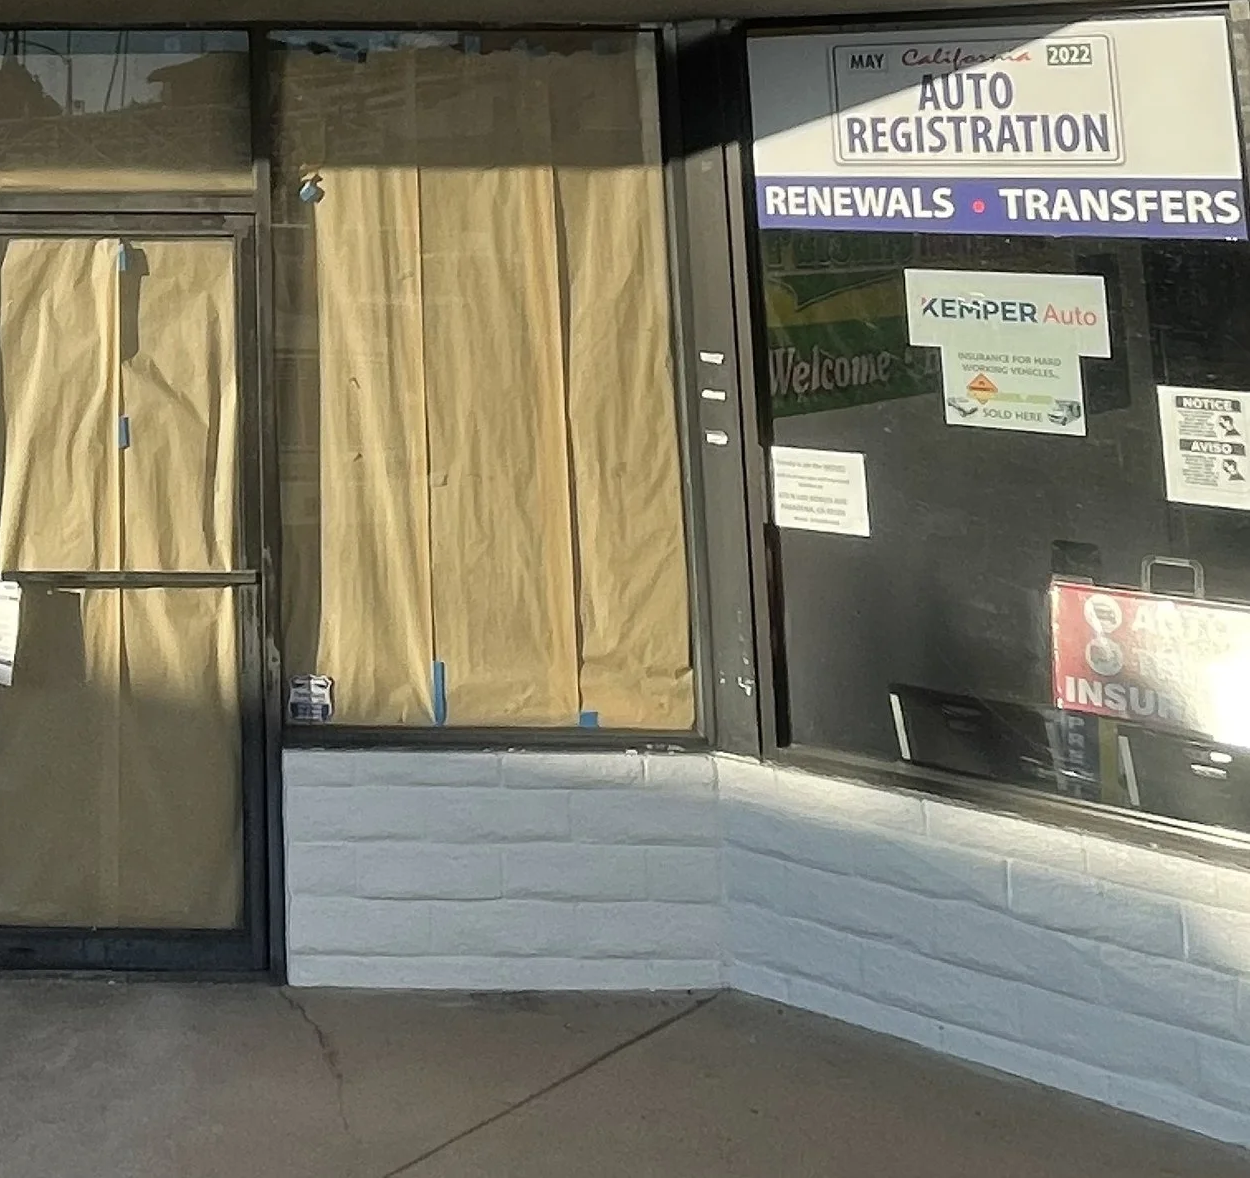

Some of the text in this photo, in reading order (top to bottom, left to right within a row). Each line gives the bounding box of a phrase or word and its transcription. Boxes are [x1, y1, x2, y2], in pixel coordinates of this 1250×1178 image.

[850, 45, 1092, 71] MAY California 2022
[918, 72, 1014, 111] AUTO
[846, 113, 1111, 154] REGISTRATION
[764, 185, 1241, 224] RENEWALS TRANSFERS
[921, 297, 1098, 326] KEMPER Auto
[769, 344, 892, 397] Welcome
[958, 352, 1062, 367] INSURANCE FOR HARD
[962, 364, 1008, 374] WORKING
[982, 408, 1043, 422] SOLD HERE
[1182, 397, 1233, 412] NOTICE
[1191, 440, 1233, 455] AVISO
[1065, 675, 1182, 719] INSUR
